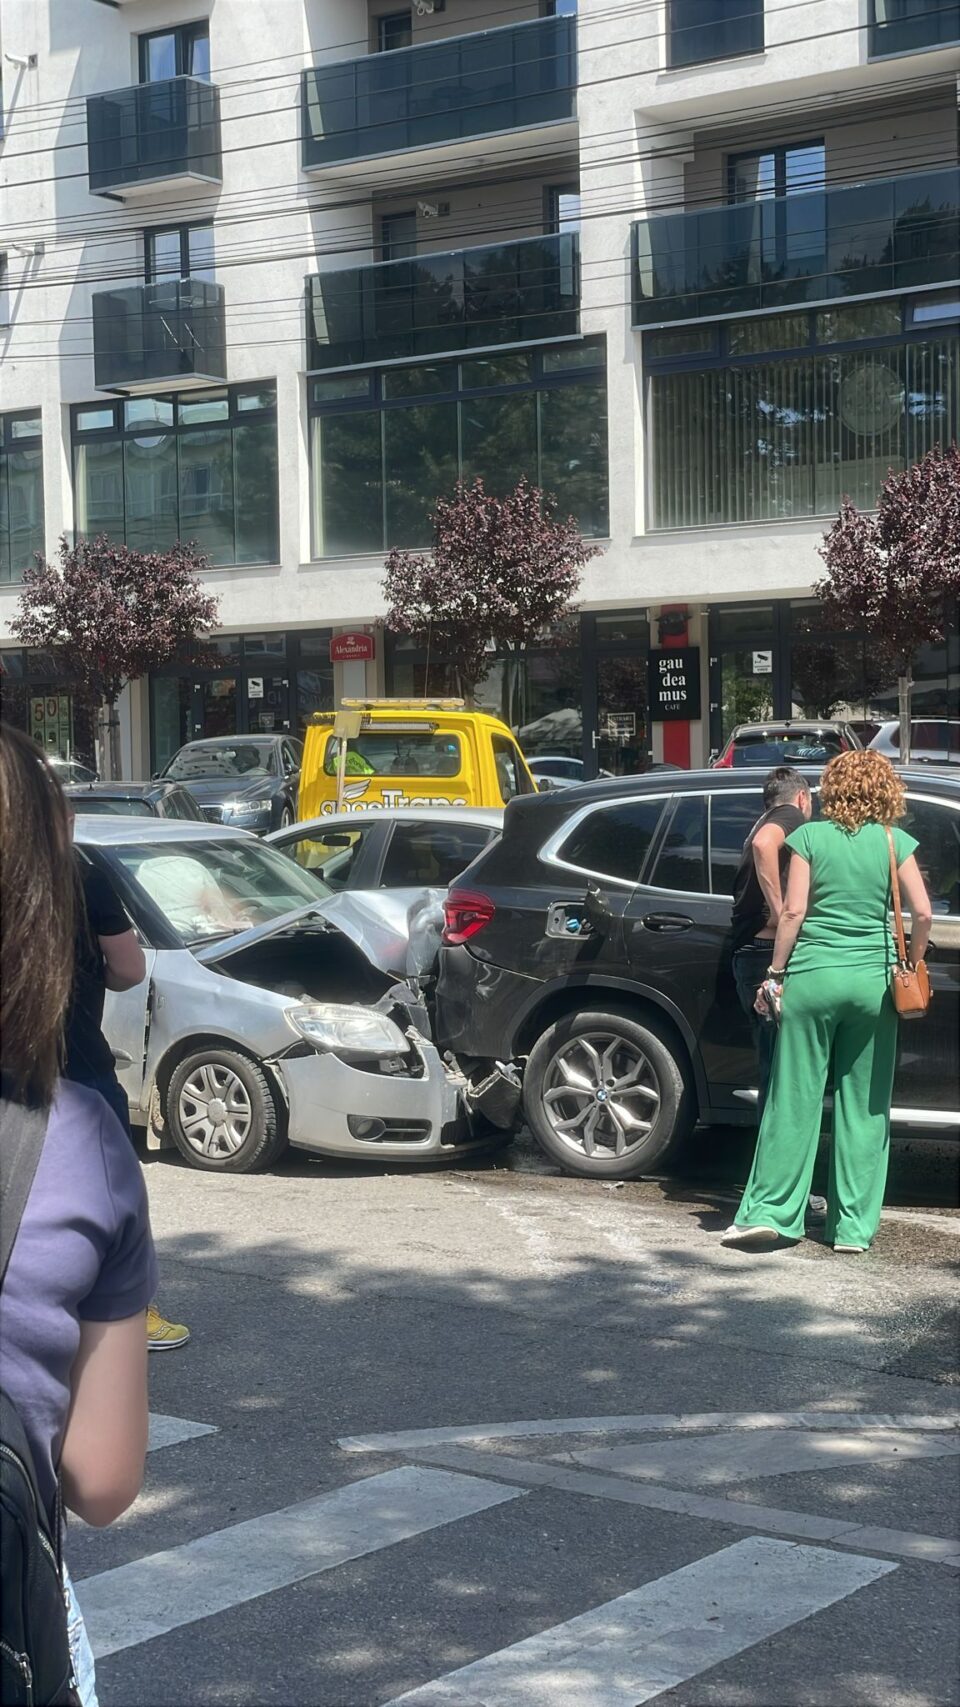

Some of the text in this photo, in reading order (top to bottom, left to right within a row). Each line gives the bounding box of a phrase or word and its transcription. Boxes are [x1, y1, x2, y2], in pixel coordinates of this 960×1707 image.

[336, 644, 368, 654] Alexandria
[658, 658, 683, 674] gau
[662, 672, 686, 687] dea
[658, 690, 687, 702] mus
